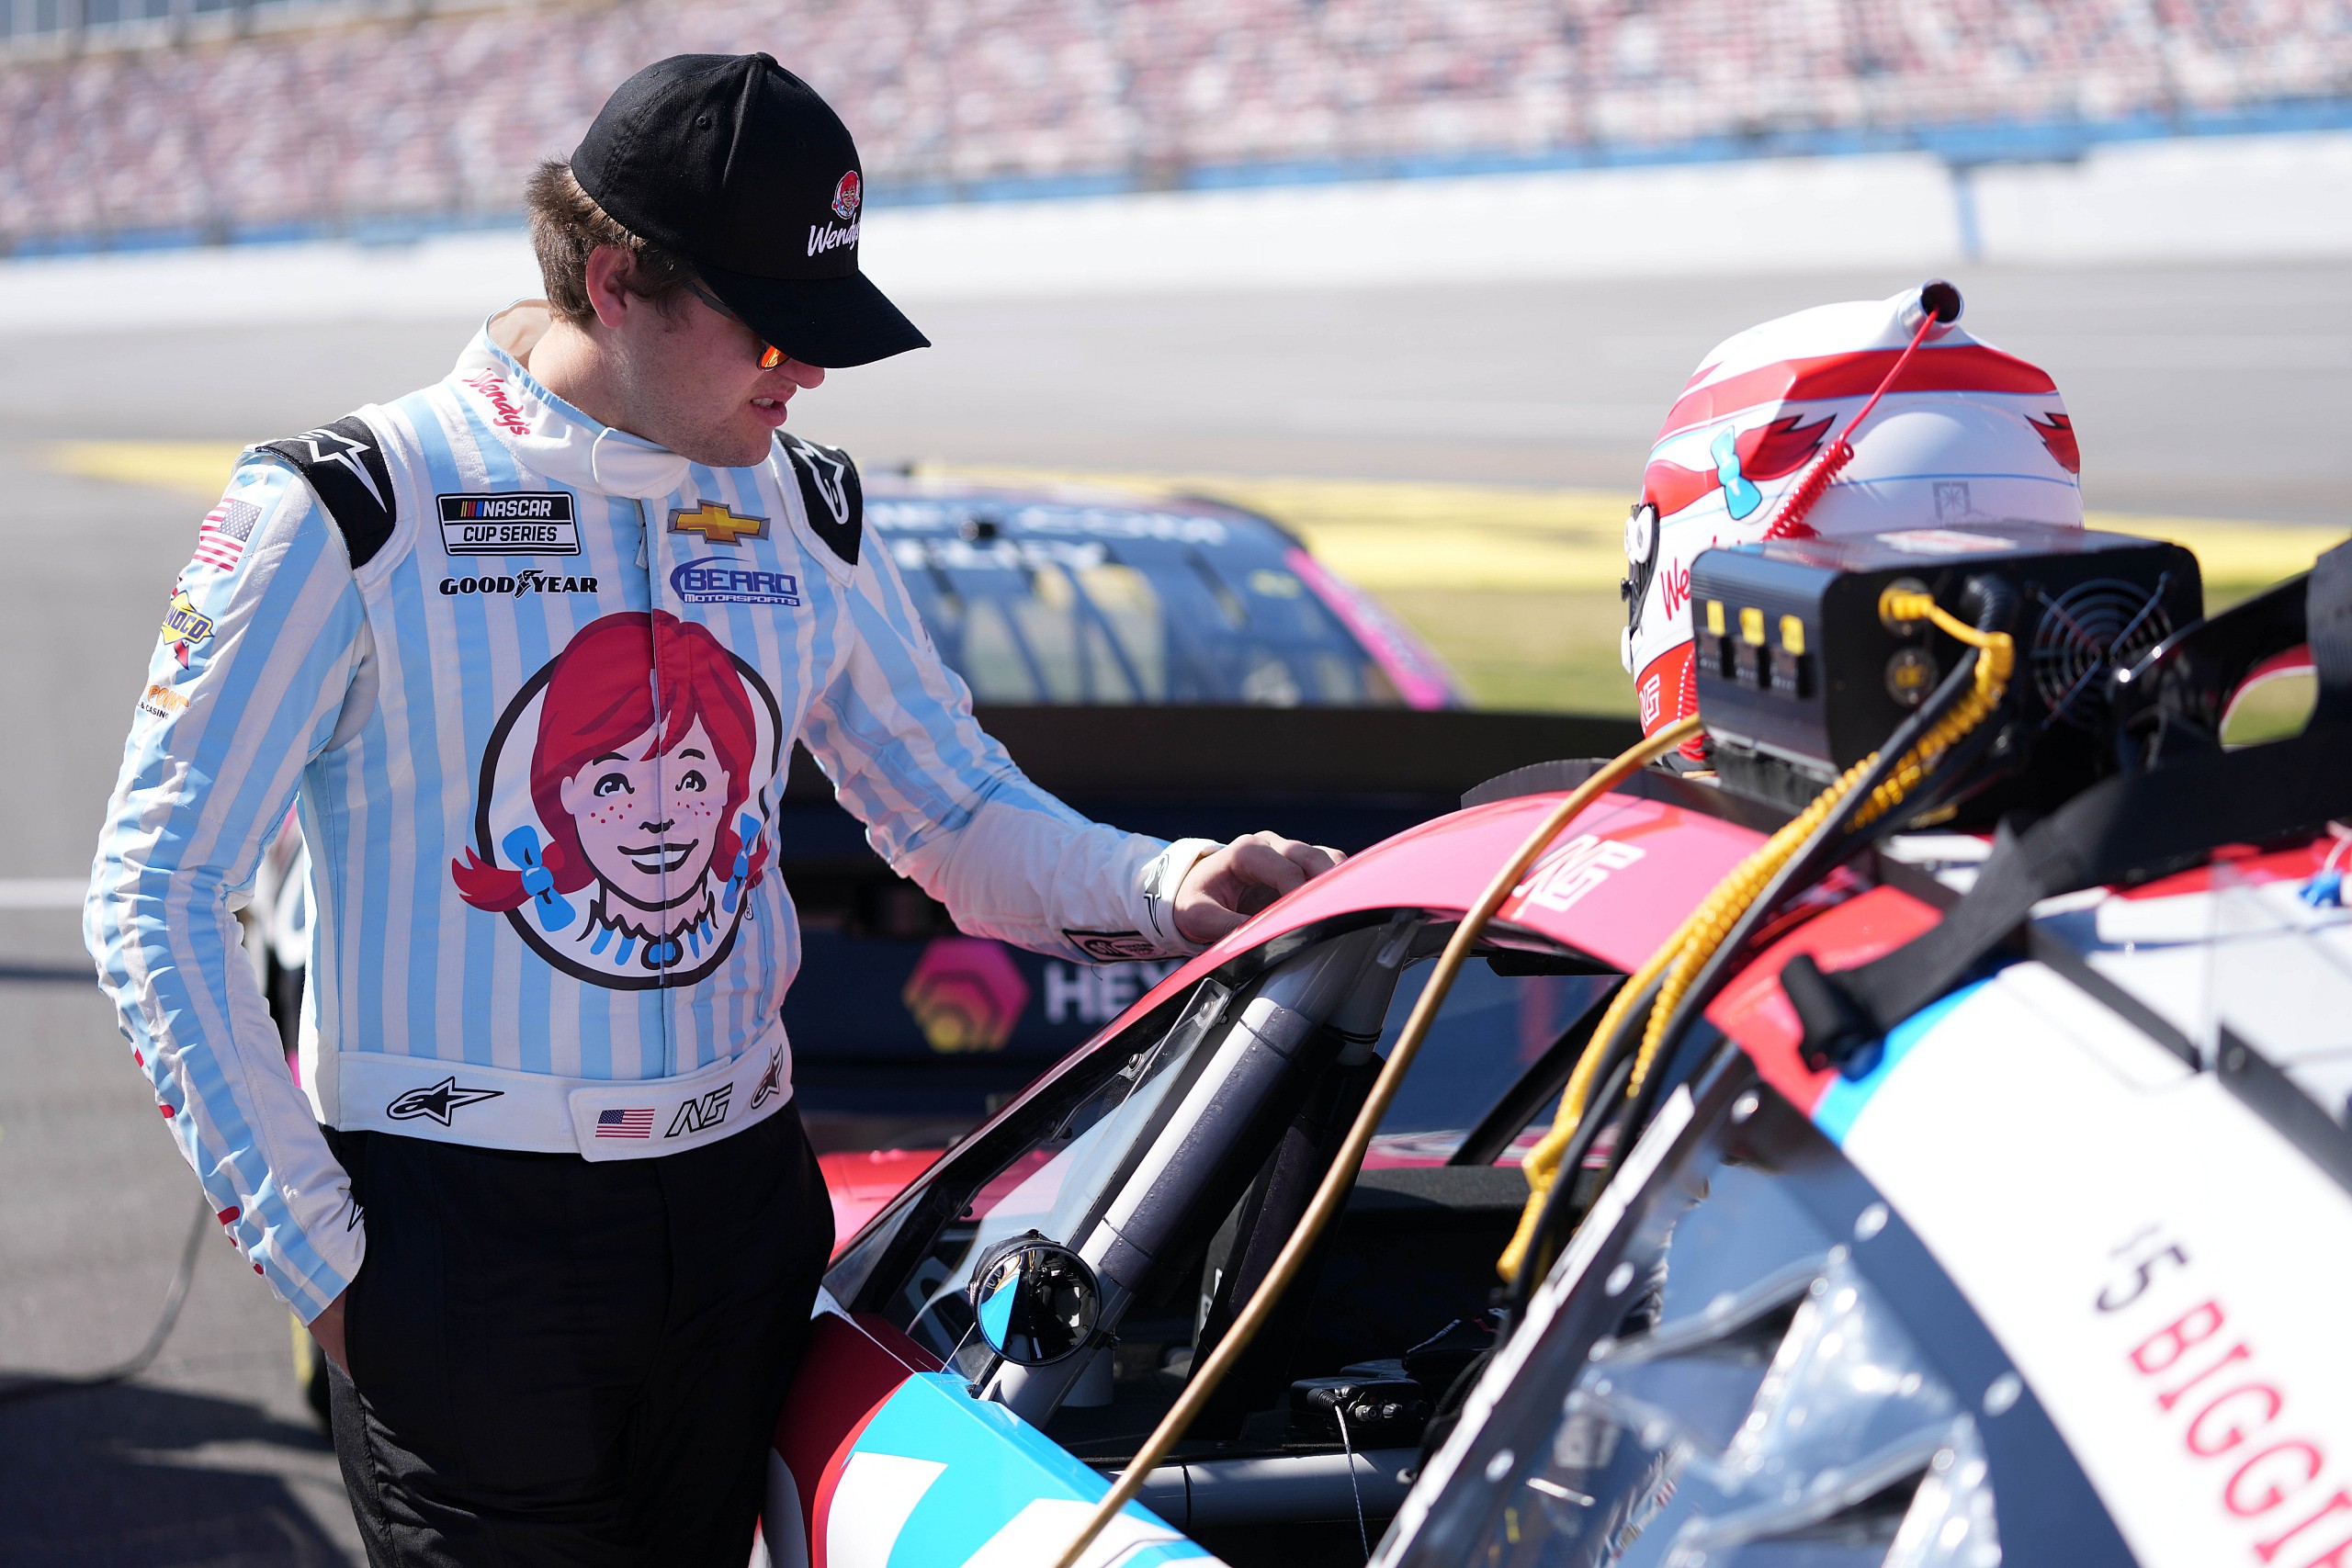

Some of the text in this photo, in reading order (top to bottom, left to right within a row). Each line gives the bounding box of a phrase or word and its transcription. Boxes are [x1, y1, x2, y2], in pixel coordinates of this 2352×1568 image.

[461, 367, 531, 435] Wendy's
[482, 500, 552, 517] NASCAR
[463, 526, 558, 542] CUP SERIES
[439, 575, 598, 595] GOODYEAR
[684, 569, 798, 596] BEARD
[684, 592, 797, 605] MOTORSPORTS
[164, 605, 209, 639] NOCO
[148, 684, 190, 713] POINT
[145, 705, 170, 720] CASINO
[2096, 1224, 2188, 1313] 5
